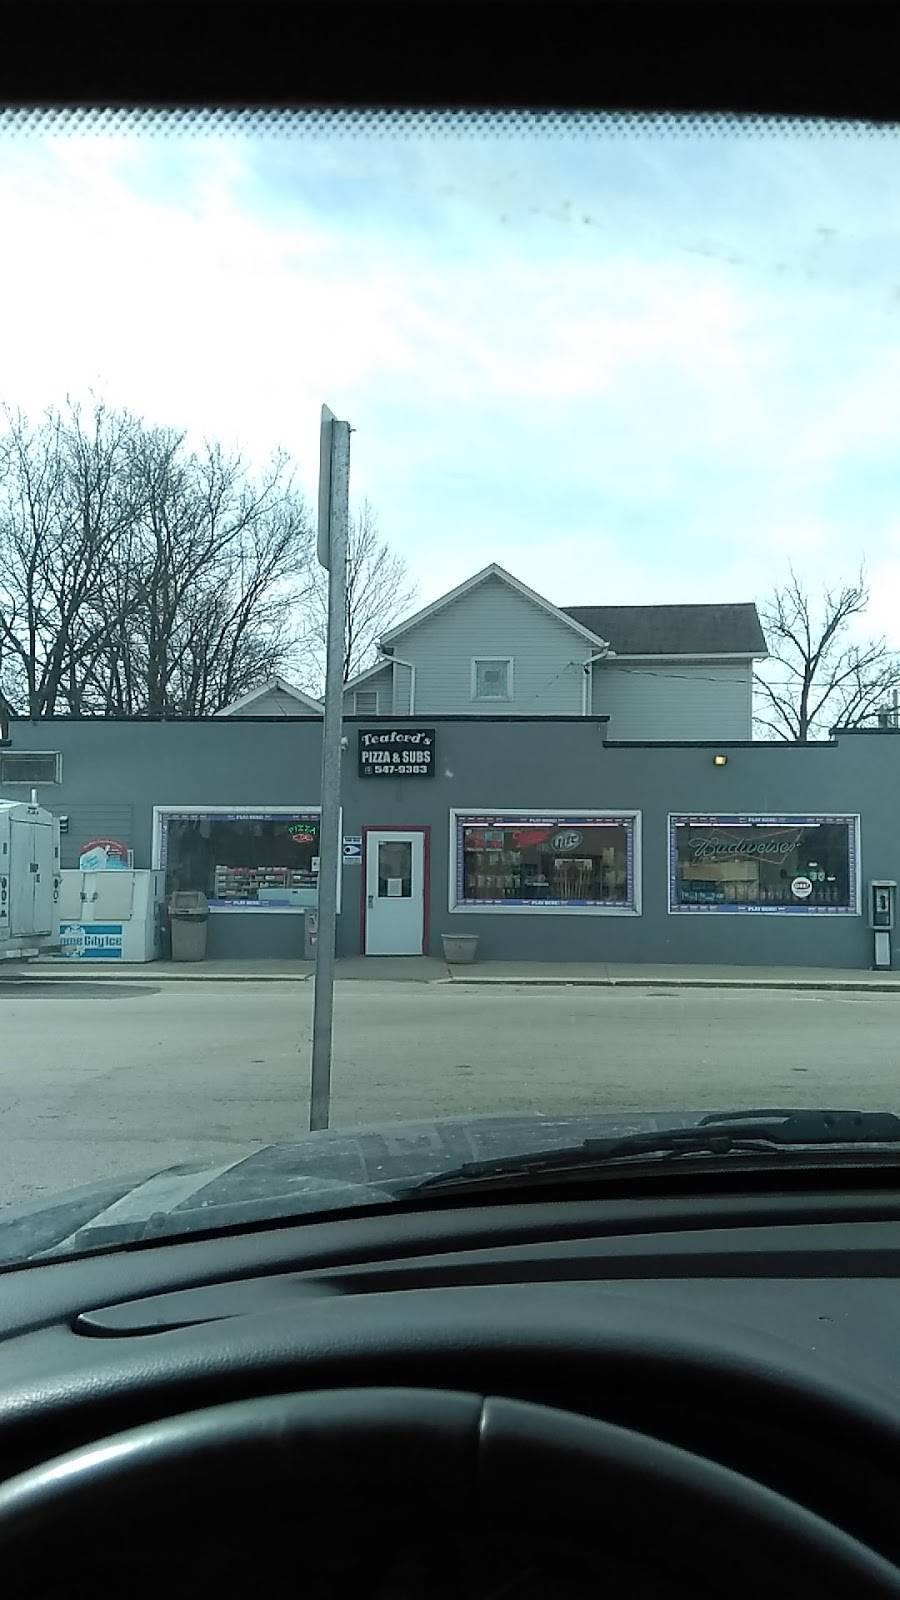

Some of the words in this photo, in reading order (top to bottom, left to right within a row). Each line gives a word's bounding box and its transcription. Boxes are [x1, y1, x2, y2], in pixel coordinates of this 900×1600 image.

[361, 731, 432, 746] Teaford's
[361, 750, 391, 763] PIZZA
[392, 752, 400, 763] &
[402, 750, 431, 763] SUBS
[288, 823, 317, 835] PIZZA
[688, 838, 800, 857] Budweiser
[84, 935, 104, 947] City
[105, 935, 121, 946] Ice
